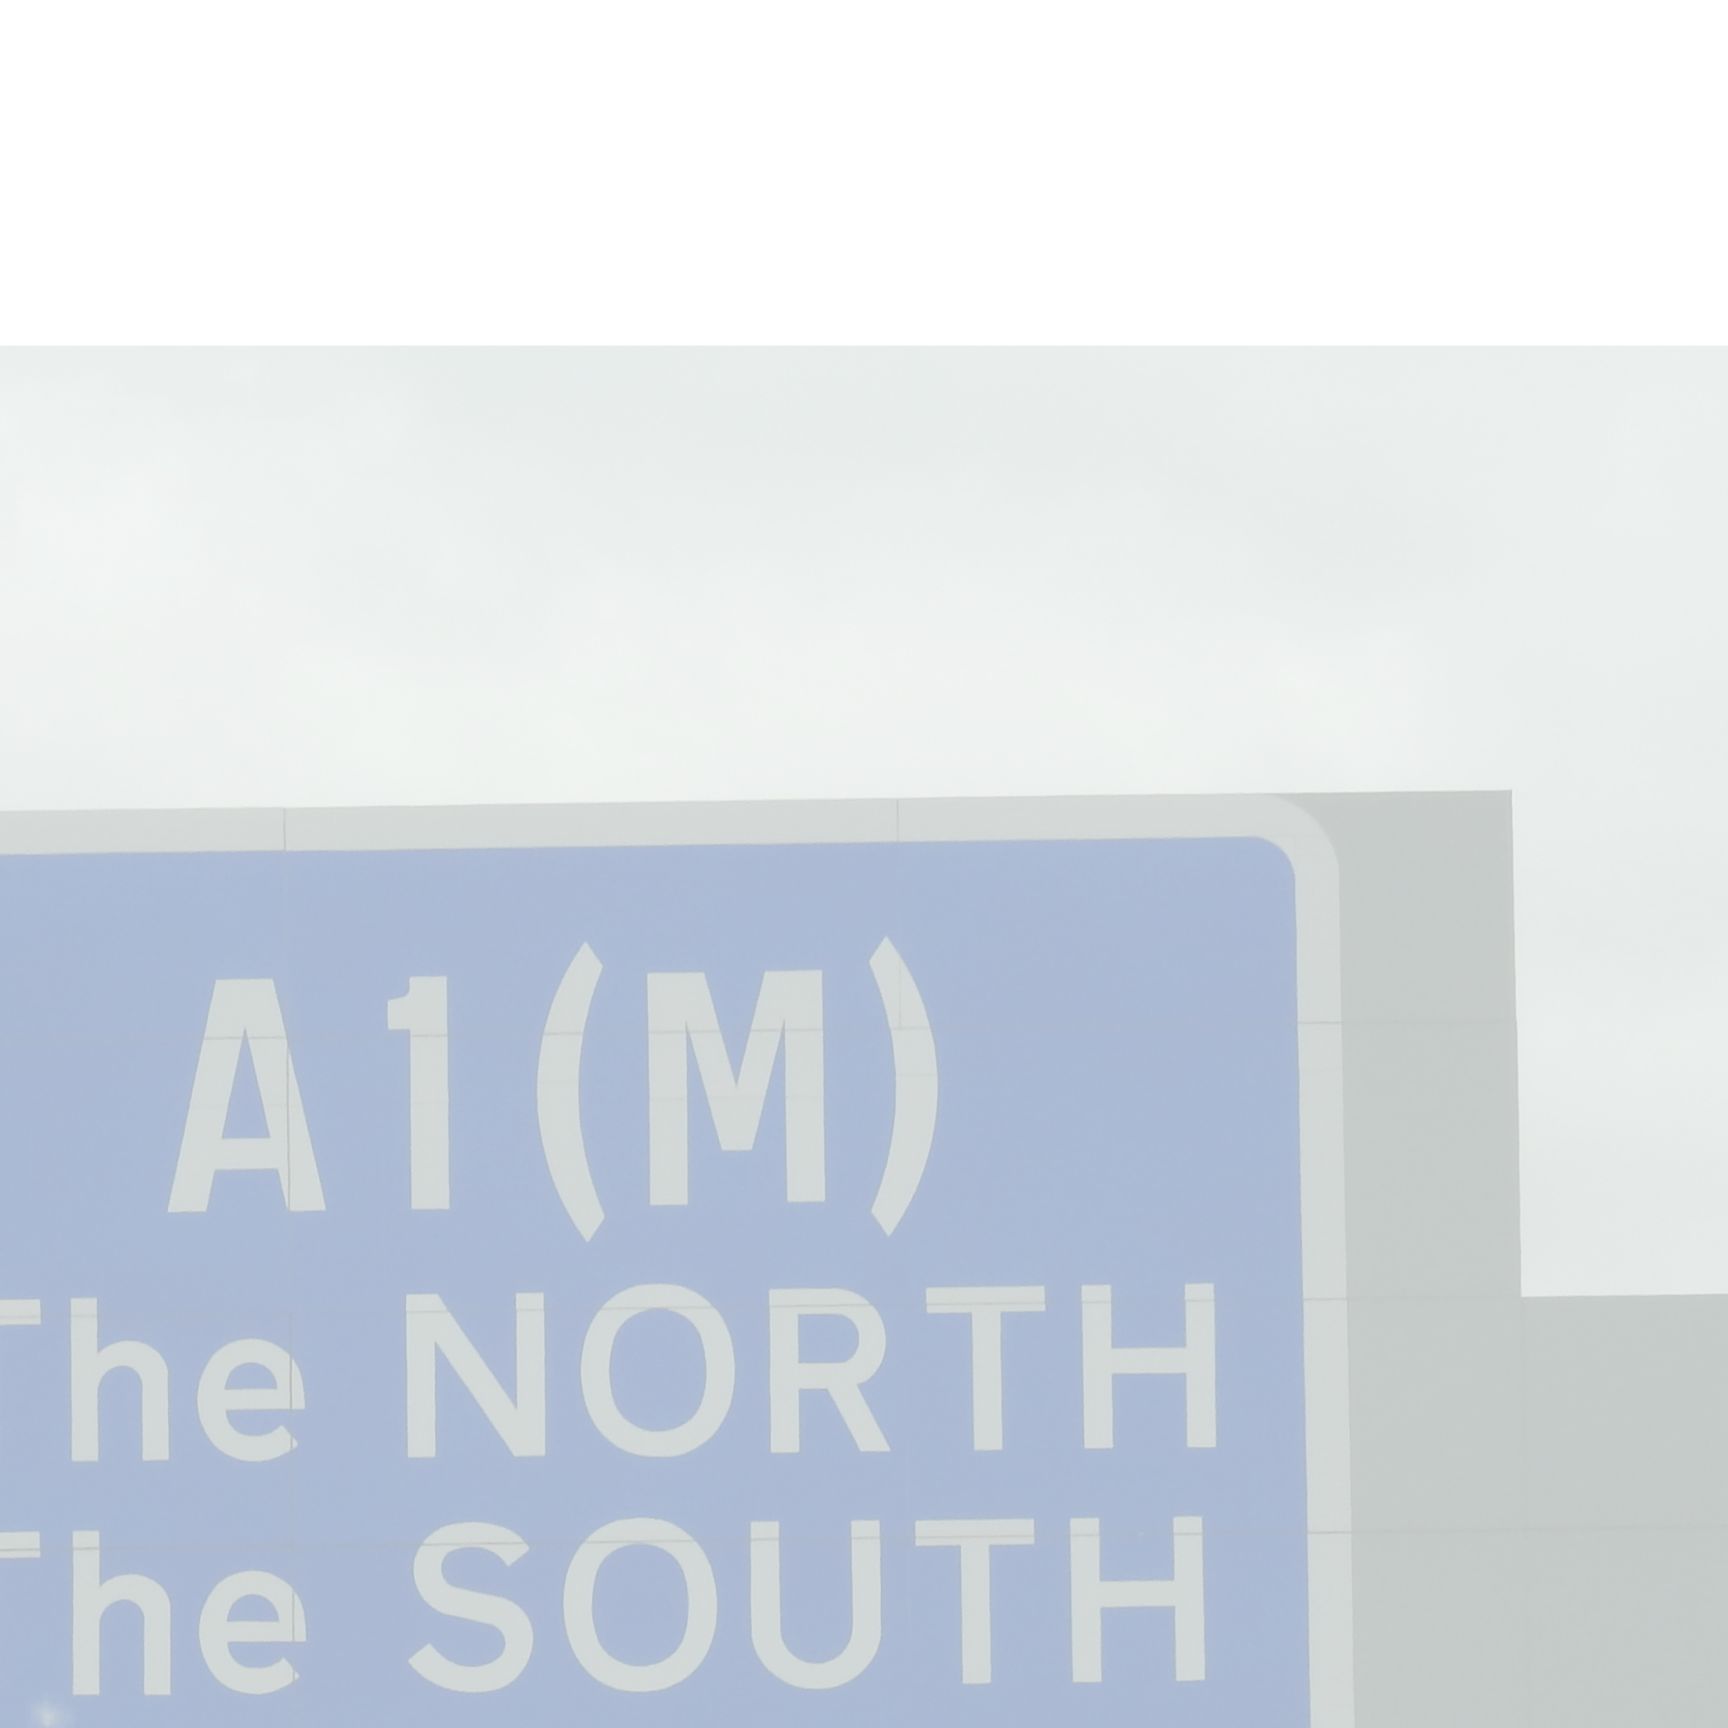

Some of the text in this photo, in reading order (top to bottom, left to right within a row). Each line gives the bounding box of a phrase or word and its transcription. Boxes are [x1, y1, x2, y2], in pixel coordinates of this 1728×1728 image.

[168, 938, 940, 1241] A1(M)
[404, 1282, 1218, 1459] NORTH
[408, 1513, 1208, 1695] SOUTH
